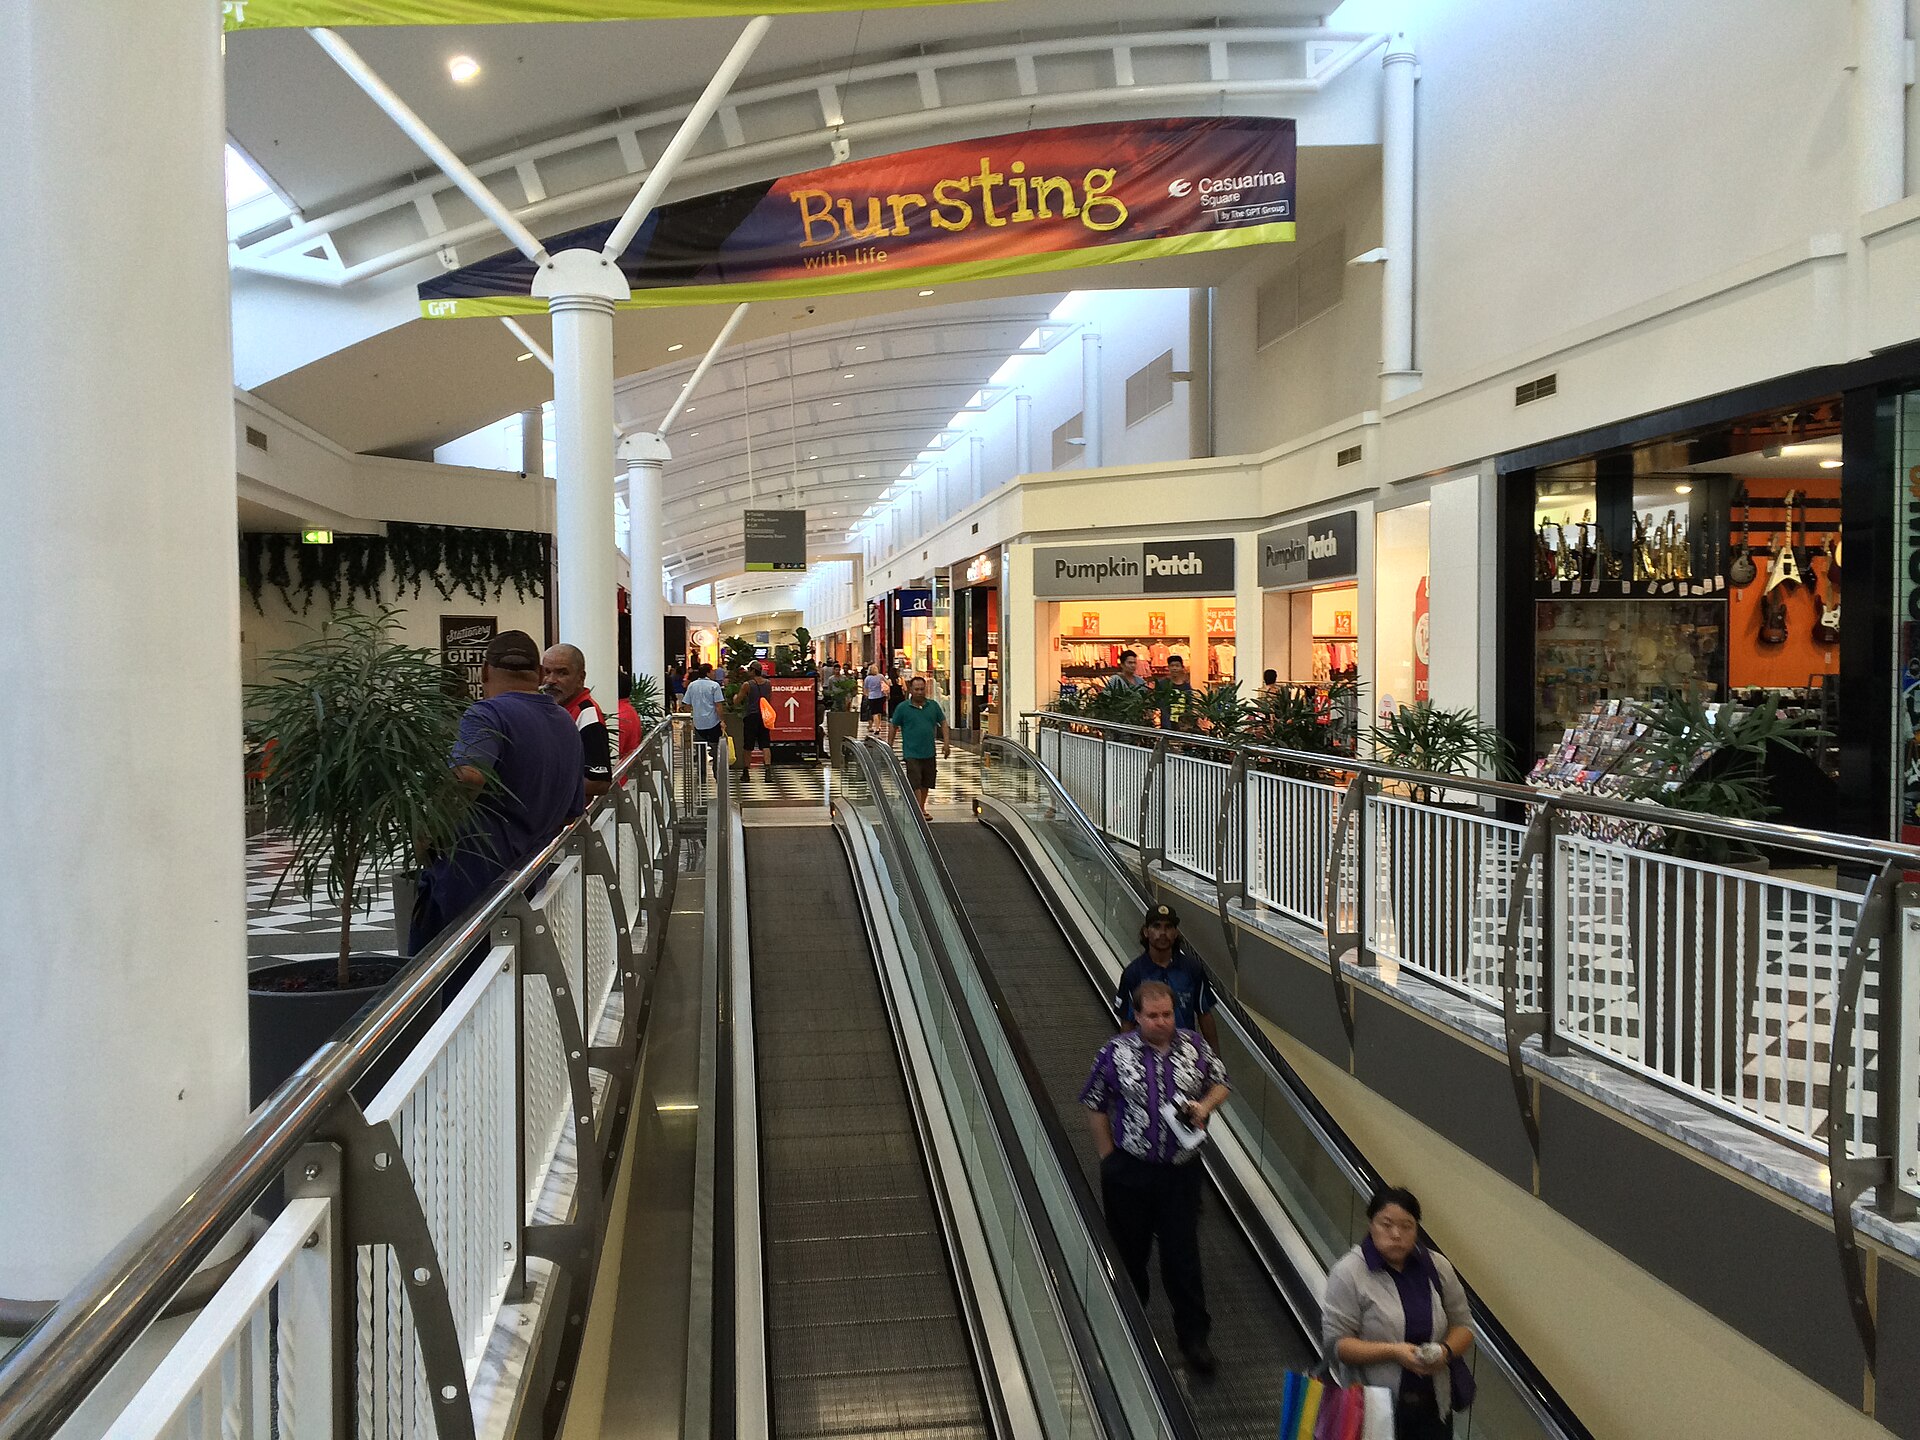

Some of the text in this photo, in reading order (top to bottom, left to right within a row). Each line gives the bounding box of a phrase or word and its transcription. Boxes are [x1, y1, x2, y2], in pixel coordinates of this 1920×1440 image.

[1198, 170, 1286, 194] Casuarina
[790, 157, 1127, 249] Bursting
[1200, 192, 1240, 207] Square
[1231, 209, 1245, 218] The
[1246, 207, 1261, 216] GPT
[1262, 204, 1285, 215] Group
[804, 247, 888, 270] with life
[428, 300, 458, 316] GPT
[1266, 530, 1337, 571] Pumpkin Patch
[1055, 552, 1203, 583] Pumpkin Patch
[446, 625, 492, 645] Stationery
